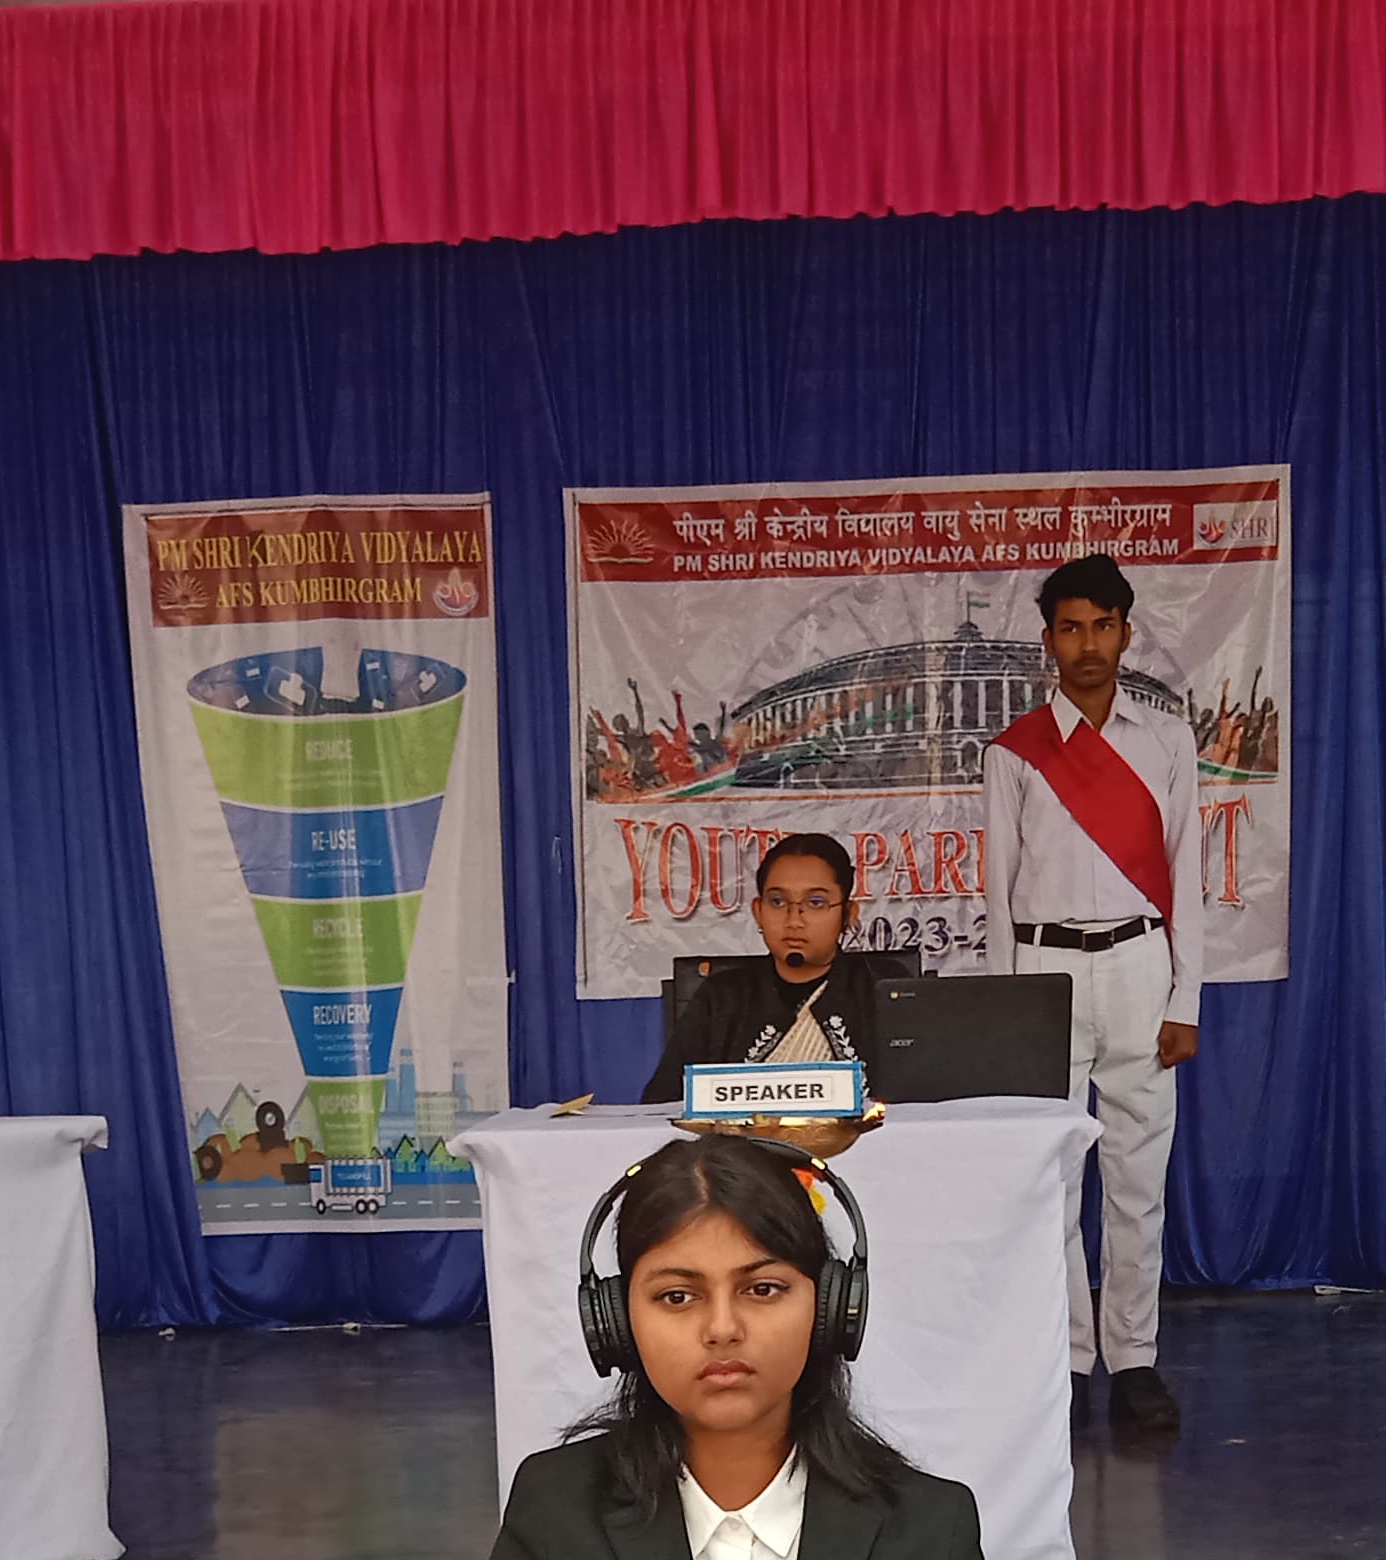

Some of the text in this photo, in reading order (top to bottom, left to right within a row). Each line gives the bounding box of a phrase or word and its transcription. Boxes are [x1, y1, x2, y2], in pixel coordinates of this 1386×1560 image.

[673, 512, 725, 545] पीएम
[732, 511, 757, 541] श्री
[835, 507, 915, 537] विद्यालय
[921, 509, 961, 541] वायु
[966, 500, 1007, 533] सेना
[1013, 503, 1061, 531] स्थल
[157, 530, 484, 571] PM SHRI KENDRIYA VIDYALAYA
[673, 537, 1180, 572] PM SHRI KENDRIYA VIDYALAYA AFS KUMBHIRGRAM
[215, 576, 423, 609] AFS KUMBHIRGRAM
[311, 829, 357, 851] RE-USE
[614, 817, 831, 921] YOUT
[841, 916, 988, 952] 2023-2
[313, 1004, 372, 1025] RECOVERY
[714, 1081, 825, 1103] SPEAKER
